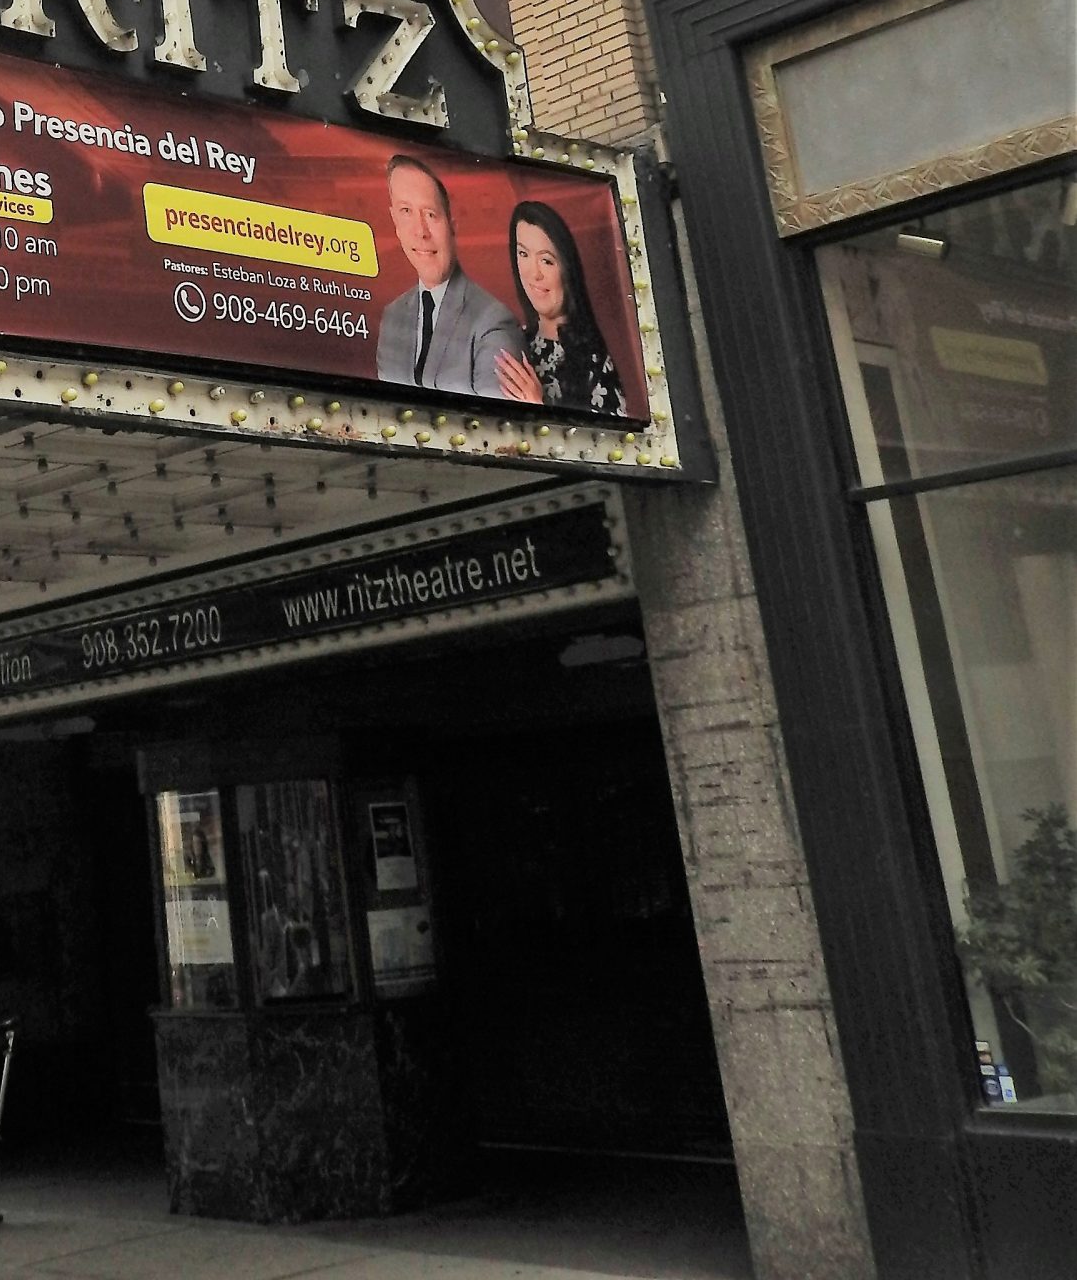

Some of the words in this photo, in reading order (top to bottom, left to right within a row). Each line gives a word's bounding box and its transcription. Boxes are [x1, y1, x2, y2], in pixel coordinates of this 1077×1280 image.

[13, 100, 152, 157] Presencia
[157, 131, 201, 166] del
[204, 140, 257, 184] Rey
[25, 236, 58, 257] am
[165, 207, 362, 263] presenciadelrey.org
[15, 274, 52, 301] pm
[163, 258, 209, 276] Pastores:
[213, 262, 265, 285] Esteban
[268, 273, 297, 290] Loza
[300, 277, 310, 291] &
[313, 278, 341, 296] Ruth
[343, 283, 372, 301] Loza
[212, 293, 370, 340] 908-469-6464
[81, 605, 222, 670] 908.352.7200
[281, 536, 541, 627] www.ritztheatre.net
